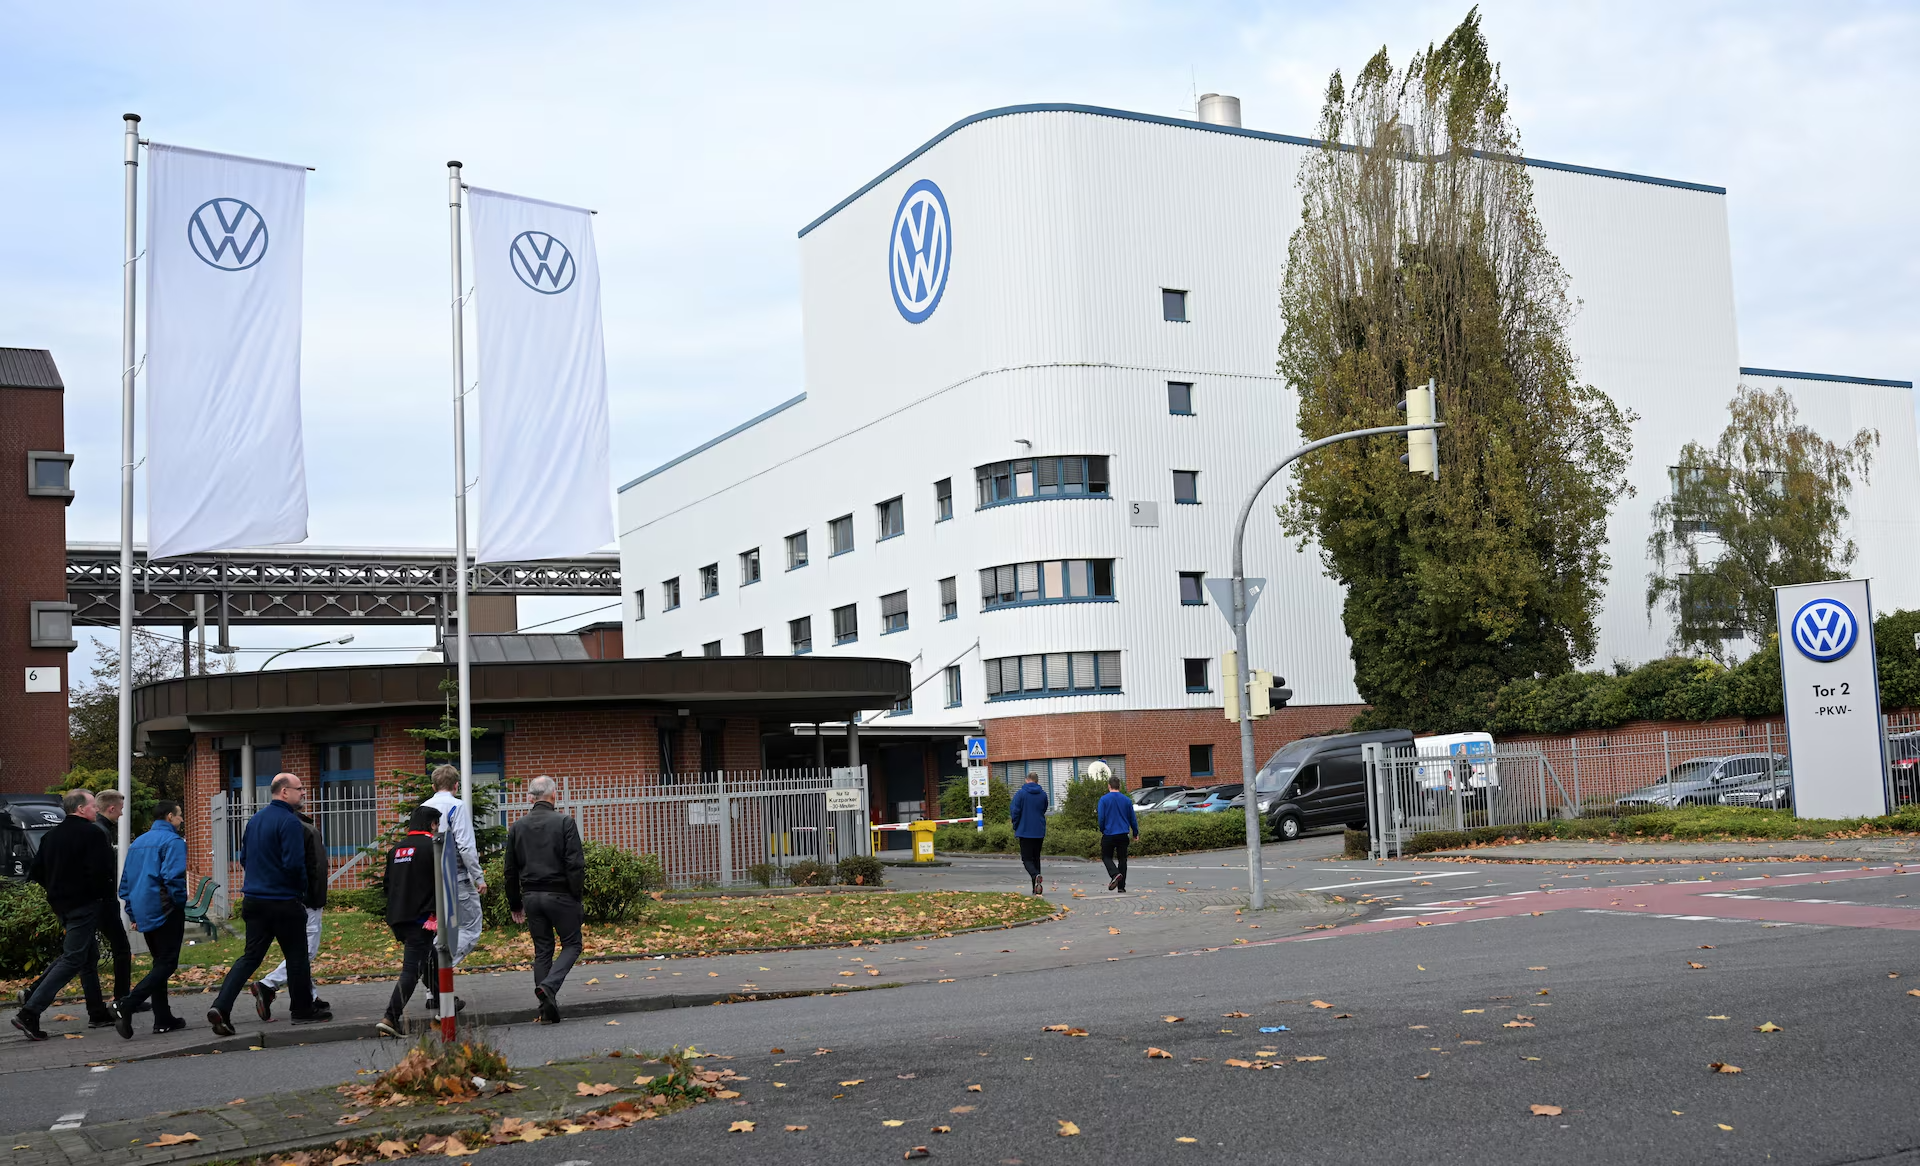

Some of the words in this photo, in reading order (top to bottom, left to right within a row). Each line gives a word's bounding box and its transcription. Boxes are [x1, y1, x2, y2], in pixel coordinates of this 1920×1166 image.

[190, 199, 267, 269] VW
[893, 190, 946, 313] VW
[511, 231, 575, 294] VW
[1133, 503, 1140, 515] 5
[1796, 602, 1852, 656] VW
[29, 669, 38, 681] 6
[1812, 684, 1836, 698] Tor
[1840, 682, 1850, 696] 2
[1814, 705, 1852, 716] -PKW-
